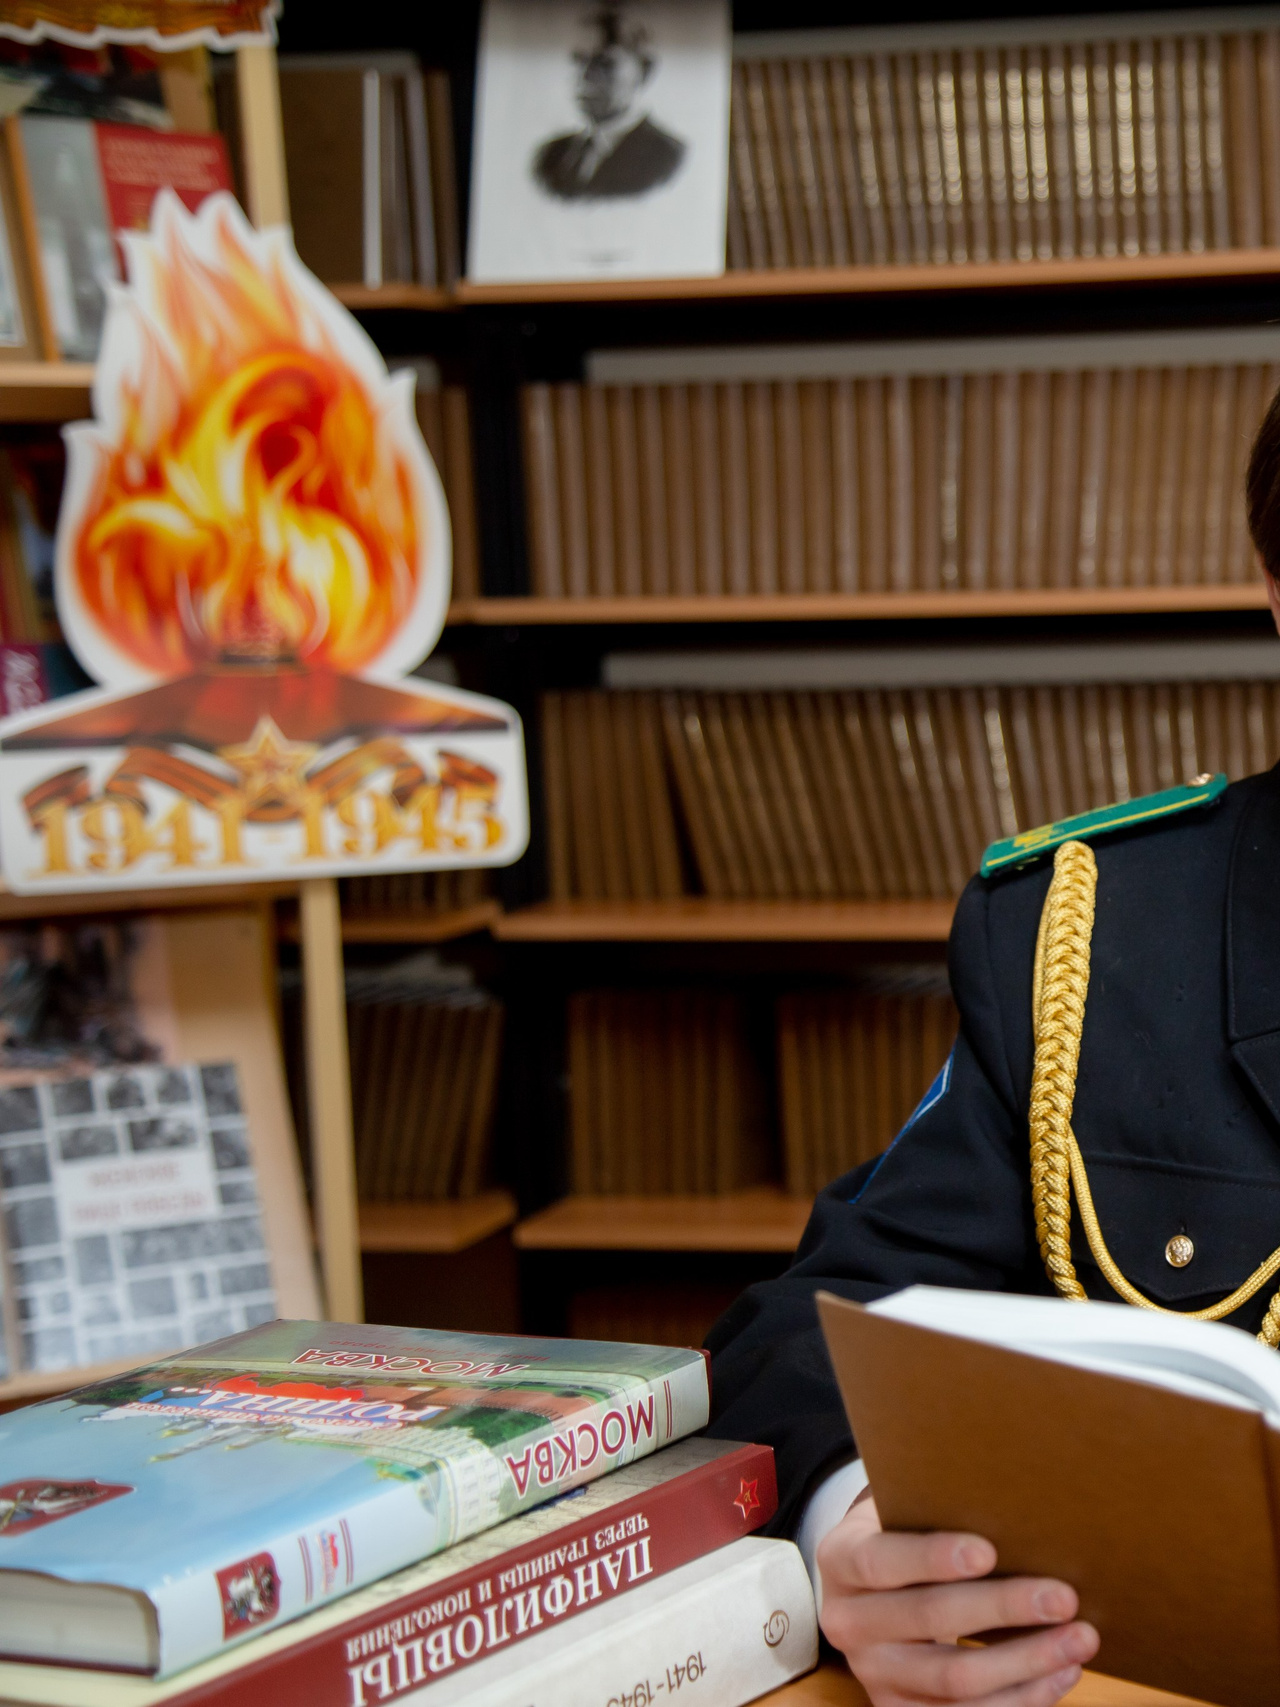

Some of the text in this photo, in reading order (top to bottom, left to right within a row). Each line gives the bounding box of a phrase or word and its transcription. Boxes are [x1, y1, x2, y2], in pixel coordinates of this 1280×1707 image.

[26, 785, 509, 877] 1941-1945
[171, 1387, 450, 1422] РОДИНА...
[291, 1348, 529, 1378] МОСКВА
[506, 1393, 655, 1499] МОСКВА
[346, 1513, 649, 1662] ЧЕРЕЗ ГРАНИЦЫ И ПОКОЛЕНИЯ
[347, 1536, 653, 1707] ПАНФИЛОВЦЫ
